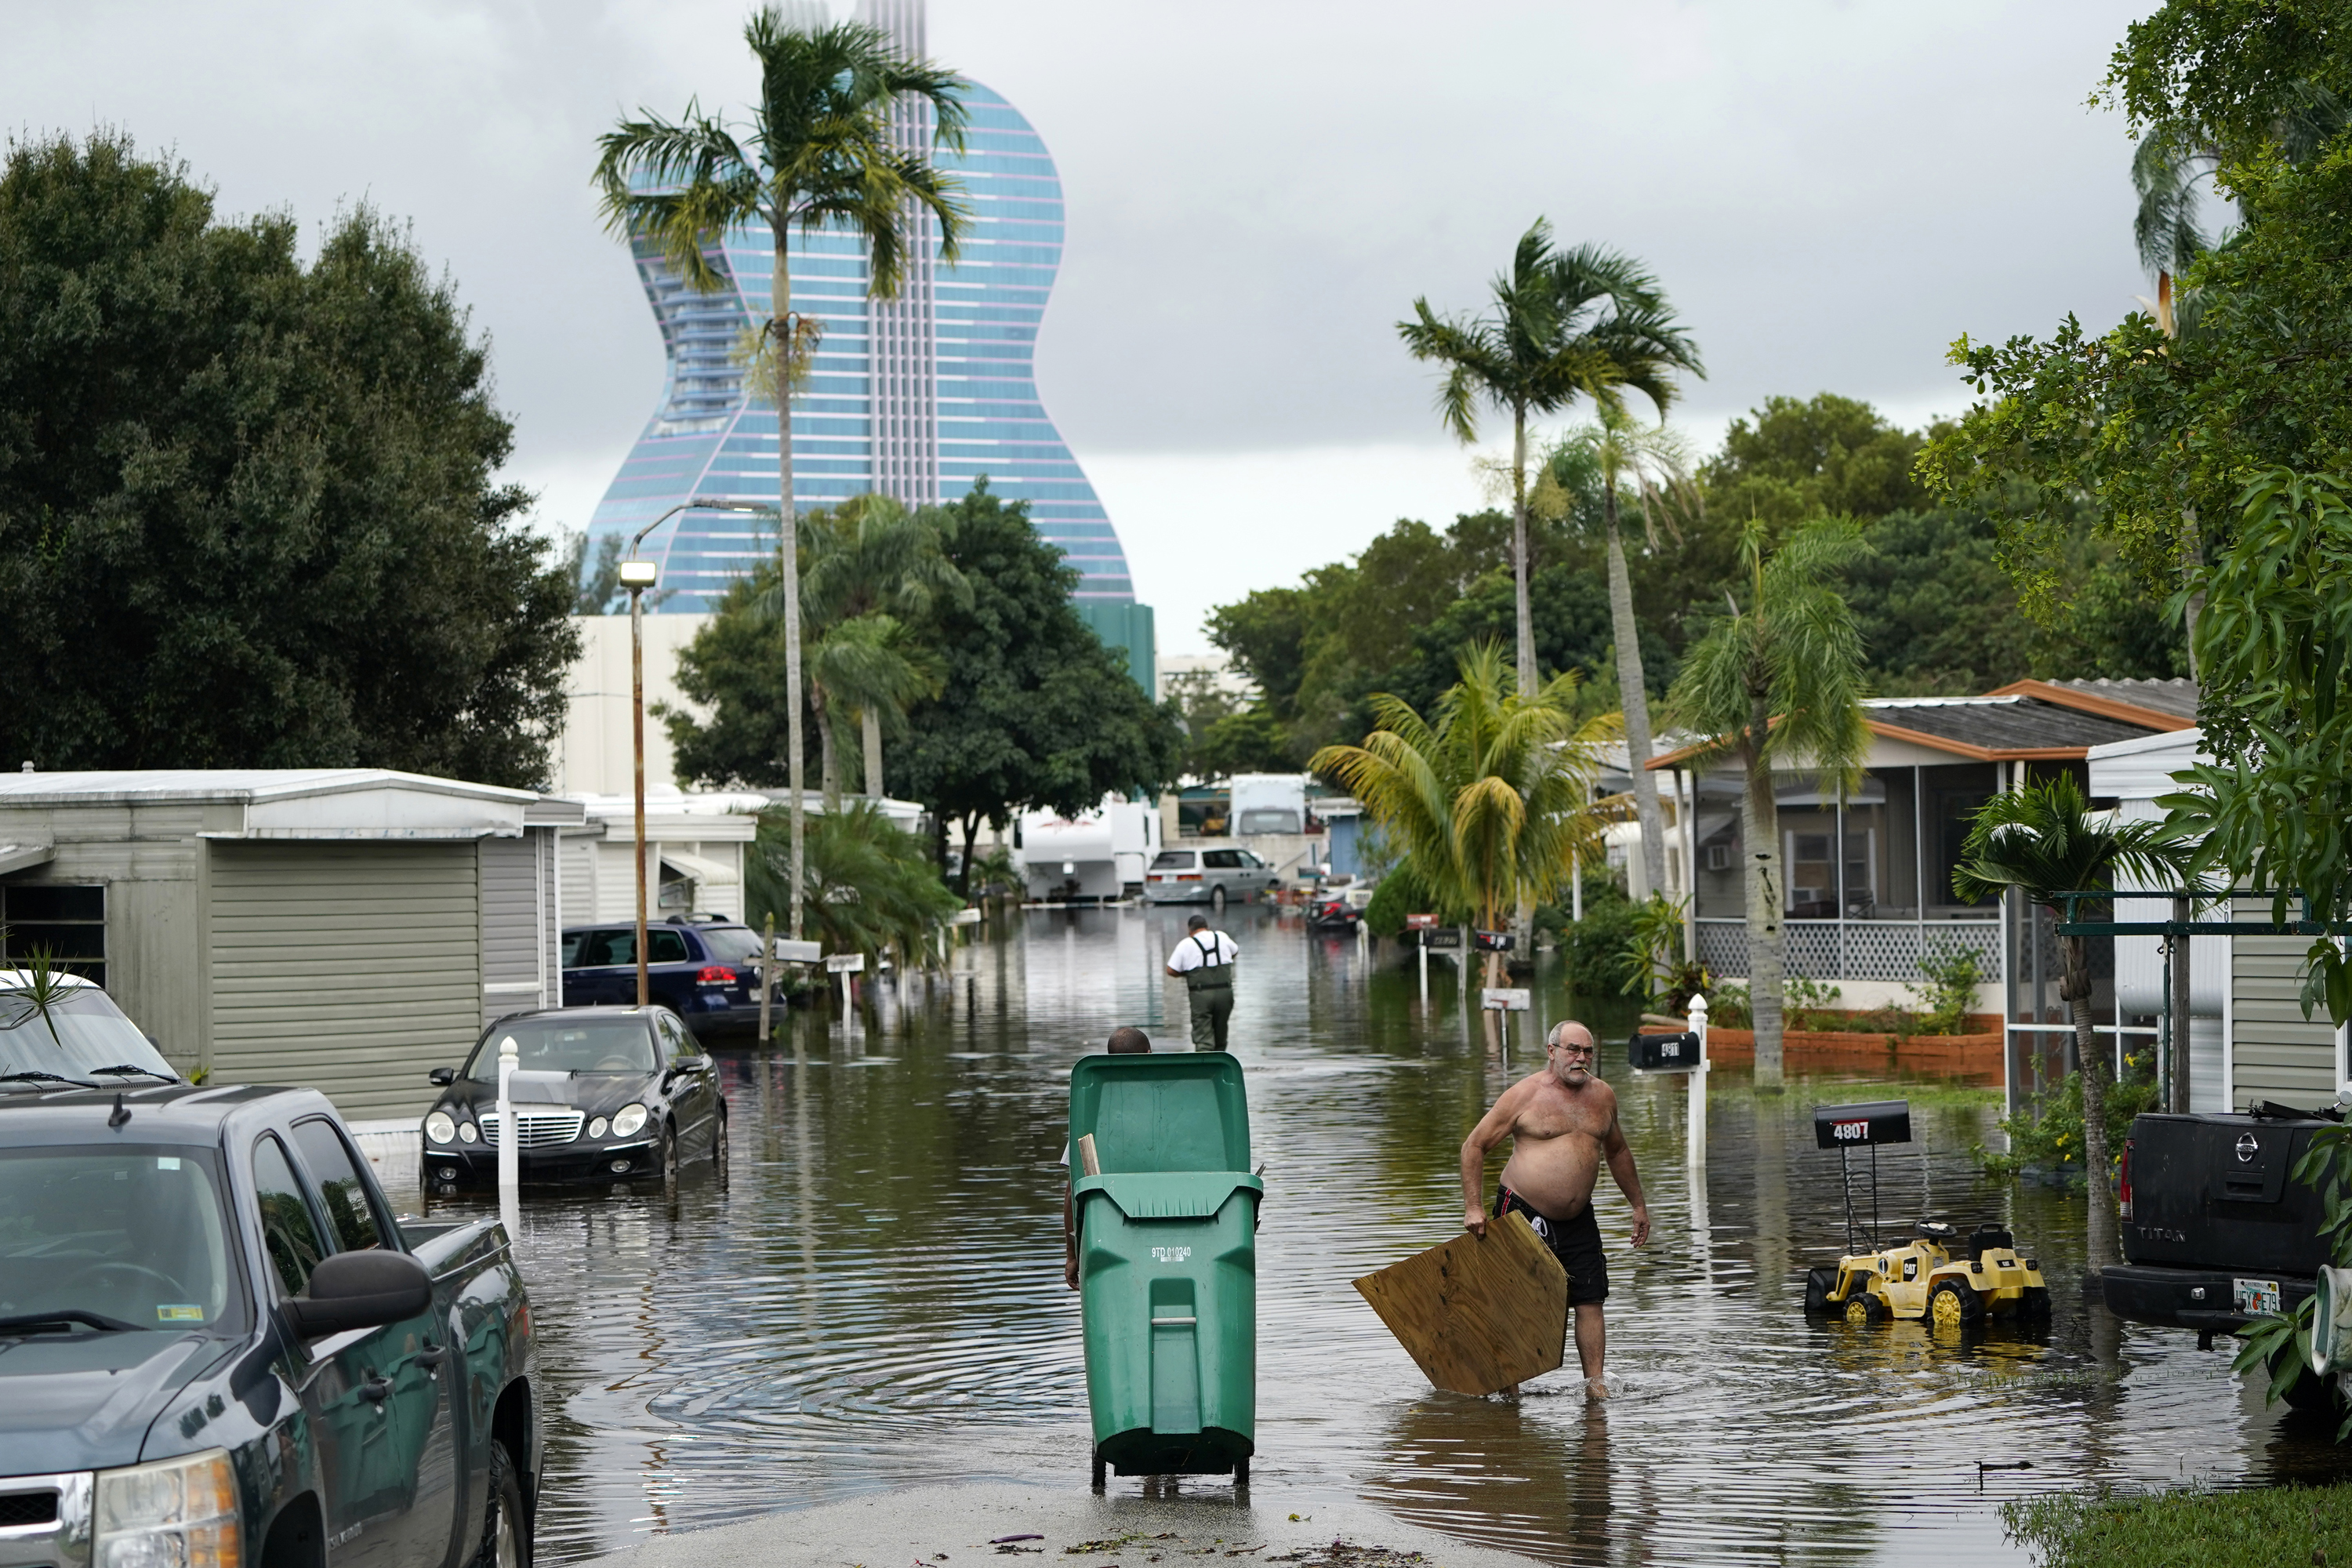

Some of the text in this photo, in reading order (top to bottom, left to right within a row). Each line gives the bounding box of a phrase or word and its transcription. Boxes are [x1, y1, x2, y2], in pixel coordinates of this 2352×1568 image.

[1661, 1043, 1679, 1057] 4811
[1834, 1122, 1868, 1139] 4807
[2136, 1226, 2186, 1242] TITAN
[1152, 1247, 1191, 1258] 9TD 010240
[1904, 1262, 1917, 1275] CAT
[2261, 1292, 2277, 1311] E79
